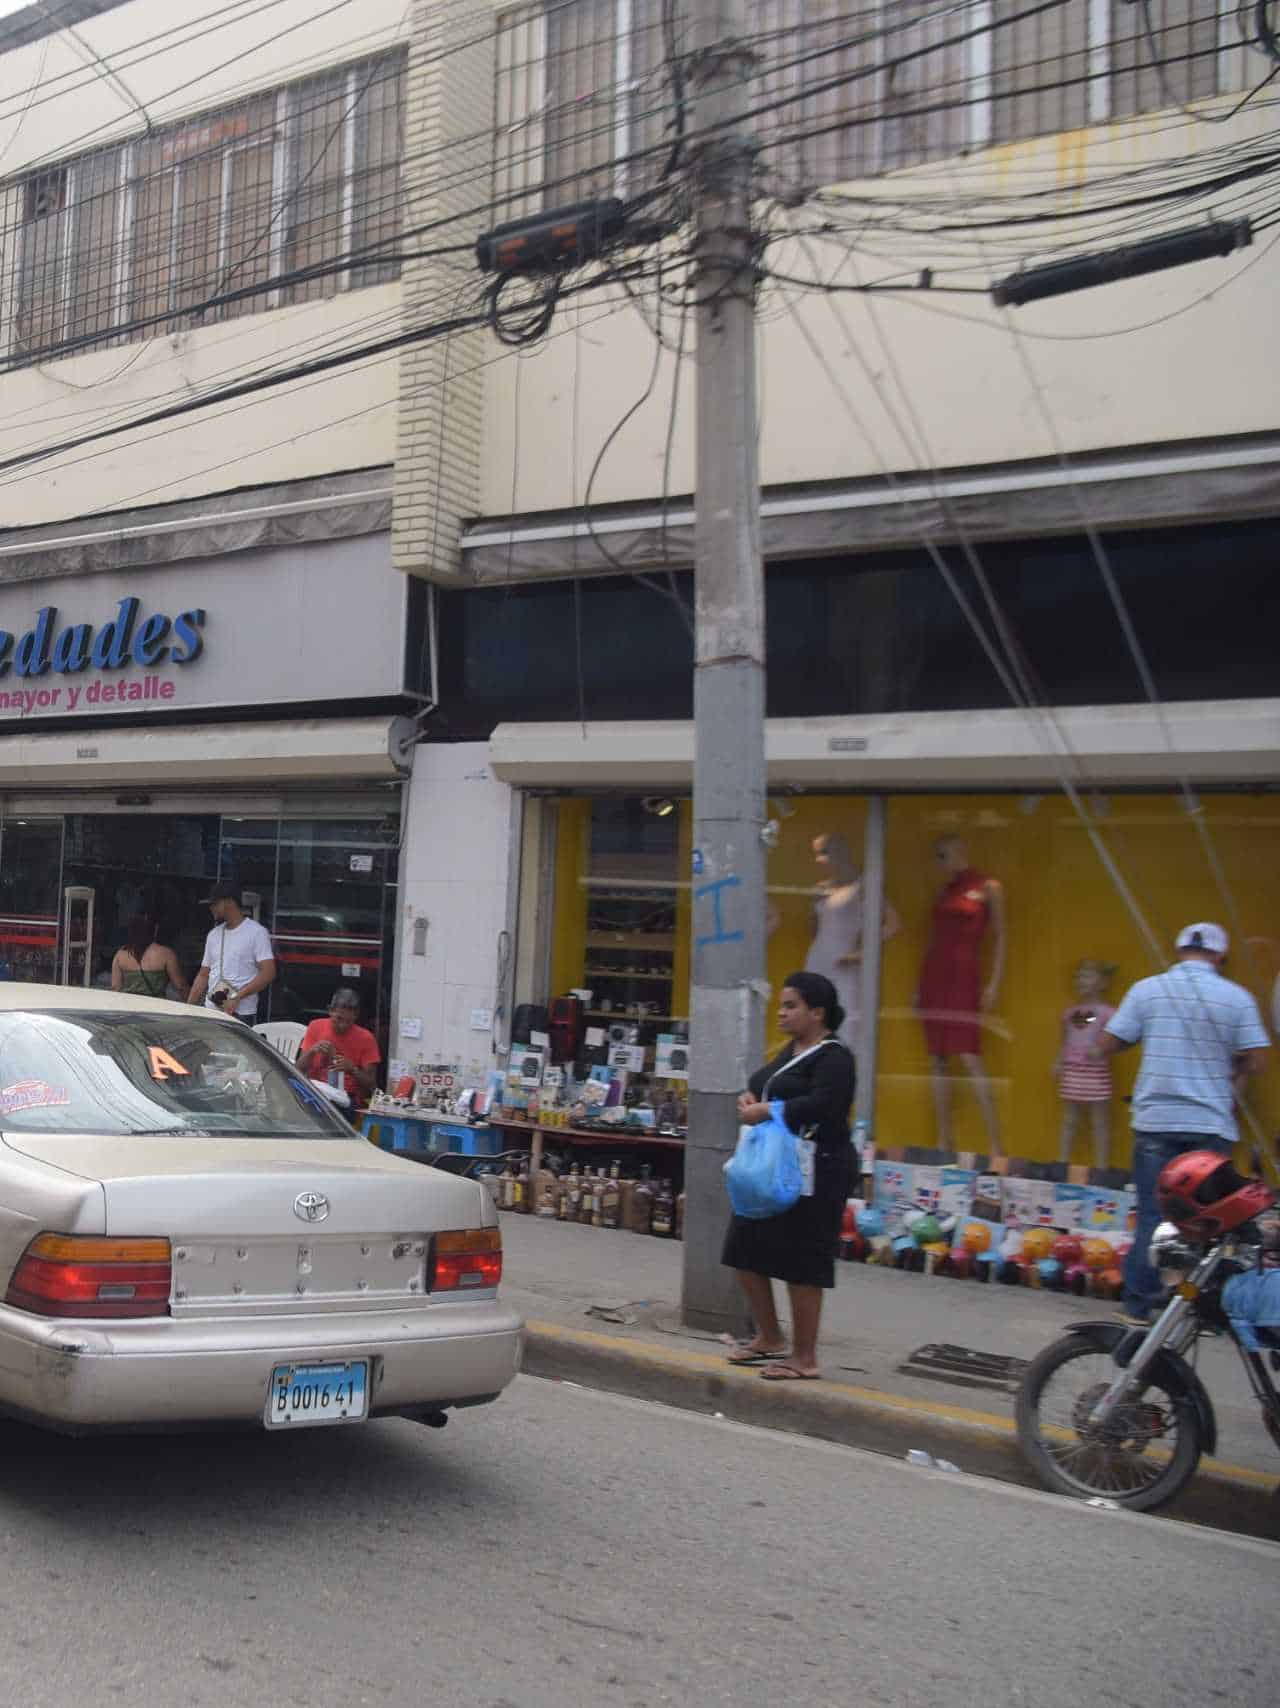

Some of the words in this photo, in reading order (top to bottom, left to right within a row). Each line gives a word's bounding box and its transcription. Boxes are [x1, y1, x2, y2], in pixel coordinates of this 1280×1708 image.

[66, 687, 81, 710] y
[86, 676, 176, 703] detalle
[146, 1045, 192, 1080] A
[420, 1074, 454, 1086] ORO
